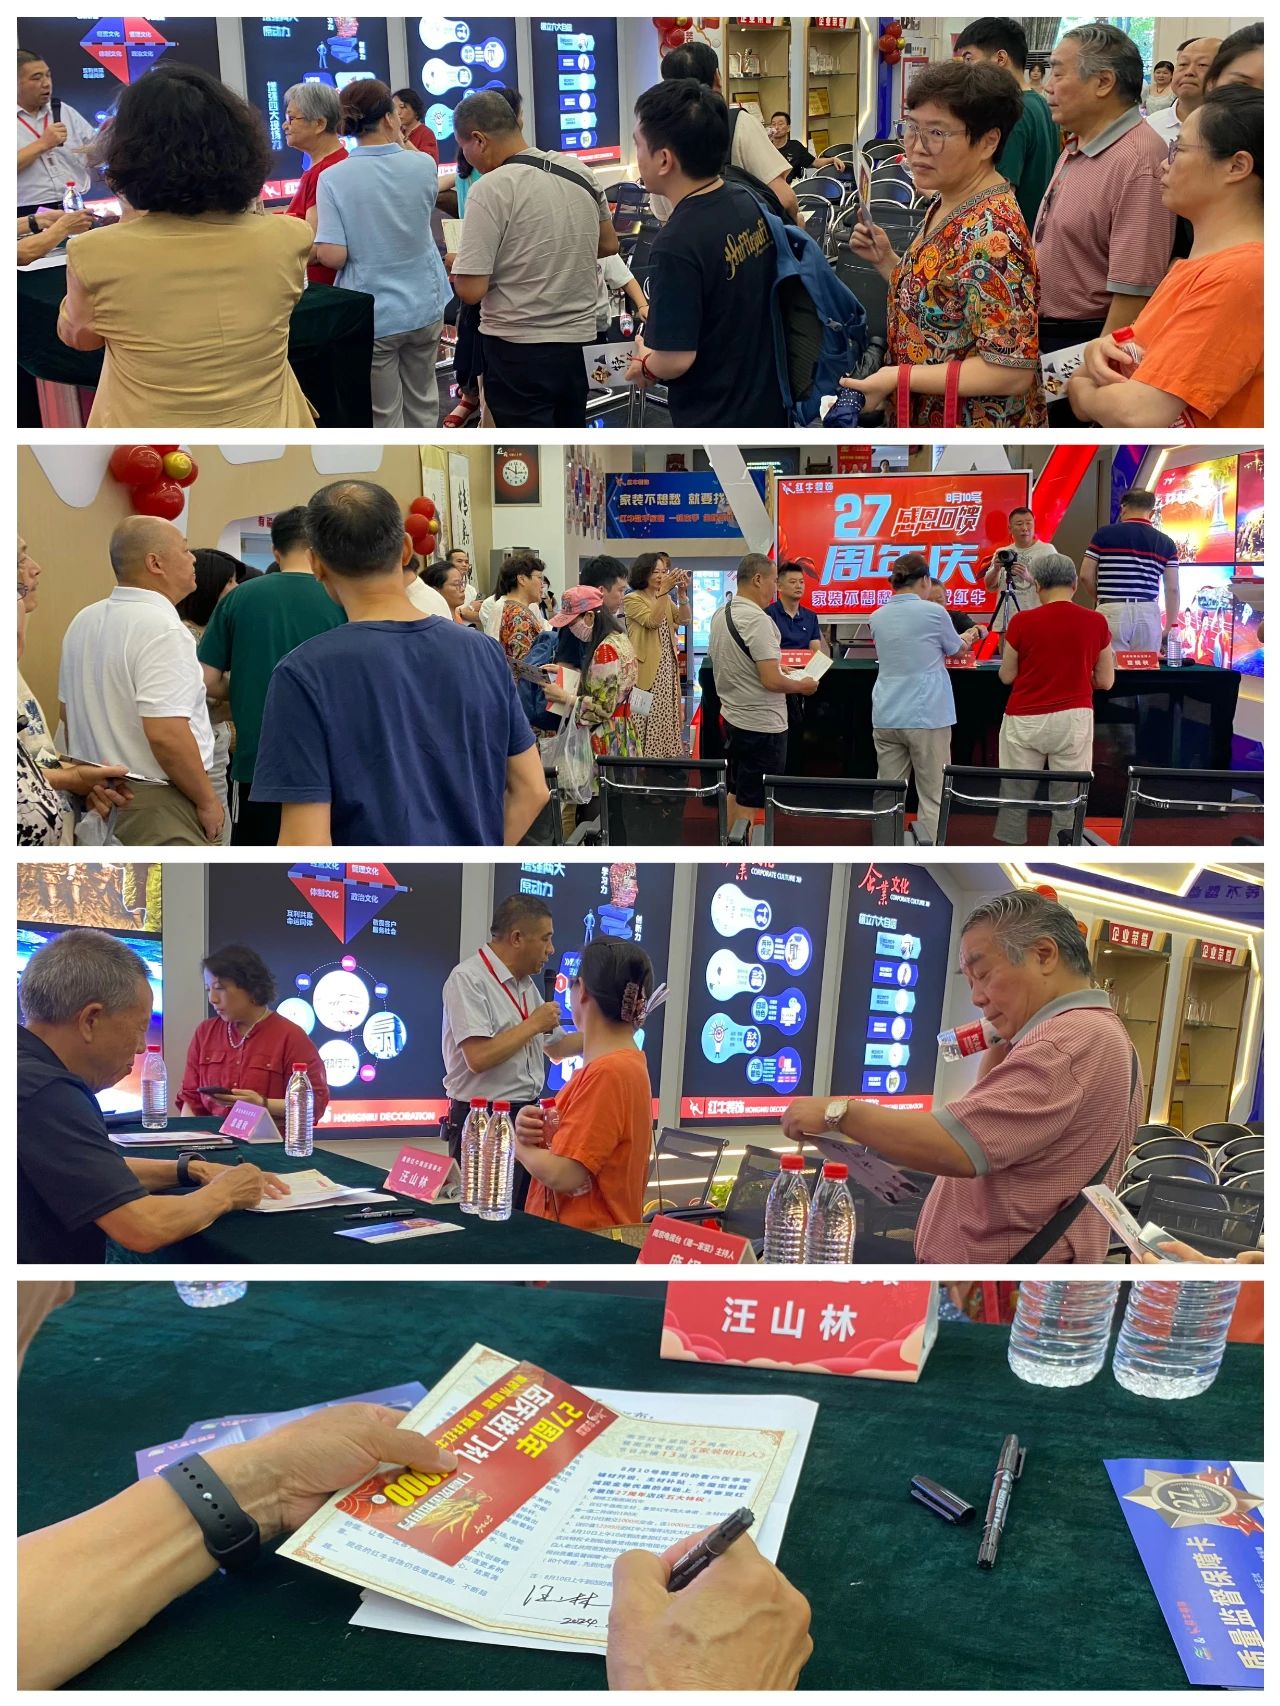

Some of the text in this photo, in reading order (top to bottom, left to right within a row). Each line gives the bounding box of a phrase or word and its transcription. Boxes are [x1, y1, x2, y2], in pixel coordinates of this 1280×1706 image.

[795, 482, 834, 492] 红牛装饰
[619, 492, 729, 506] 家装不想愁 就要找
[945, 491, 982, 504] 8月10号
[833, 493, 893, 539] 27
[891, 505, 982, 537] 感恩回馈
[819, 543, 981, 586] 周年庆
[811, 590, 893, 606] 家装不想愁
[309, 887, 340, 899] 体制文化
[350, 892, 379, 904] 政治文化
[519, 878, 554, 898] 原动力
[1111, 926, 1149, 947] 企业荣誉
[1201, 944, 1232, 963] 企业荣誉
[379, 1110, 436, 1122] DECORATION
[707, 1099, 745, 1115] 红牛装饰
[398, 1168, 430, 1189] 汪山林
[721, 1296, 858, 1342] 汪山林
[453, 1383, 556, 1465] 店庆进门礼
[515, 1401, 584, 1459] 27周年
[1186, 1536, 1264, 1670] 质量监督保障卡
